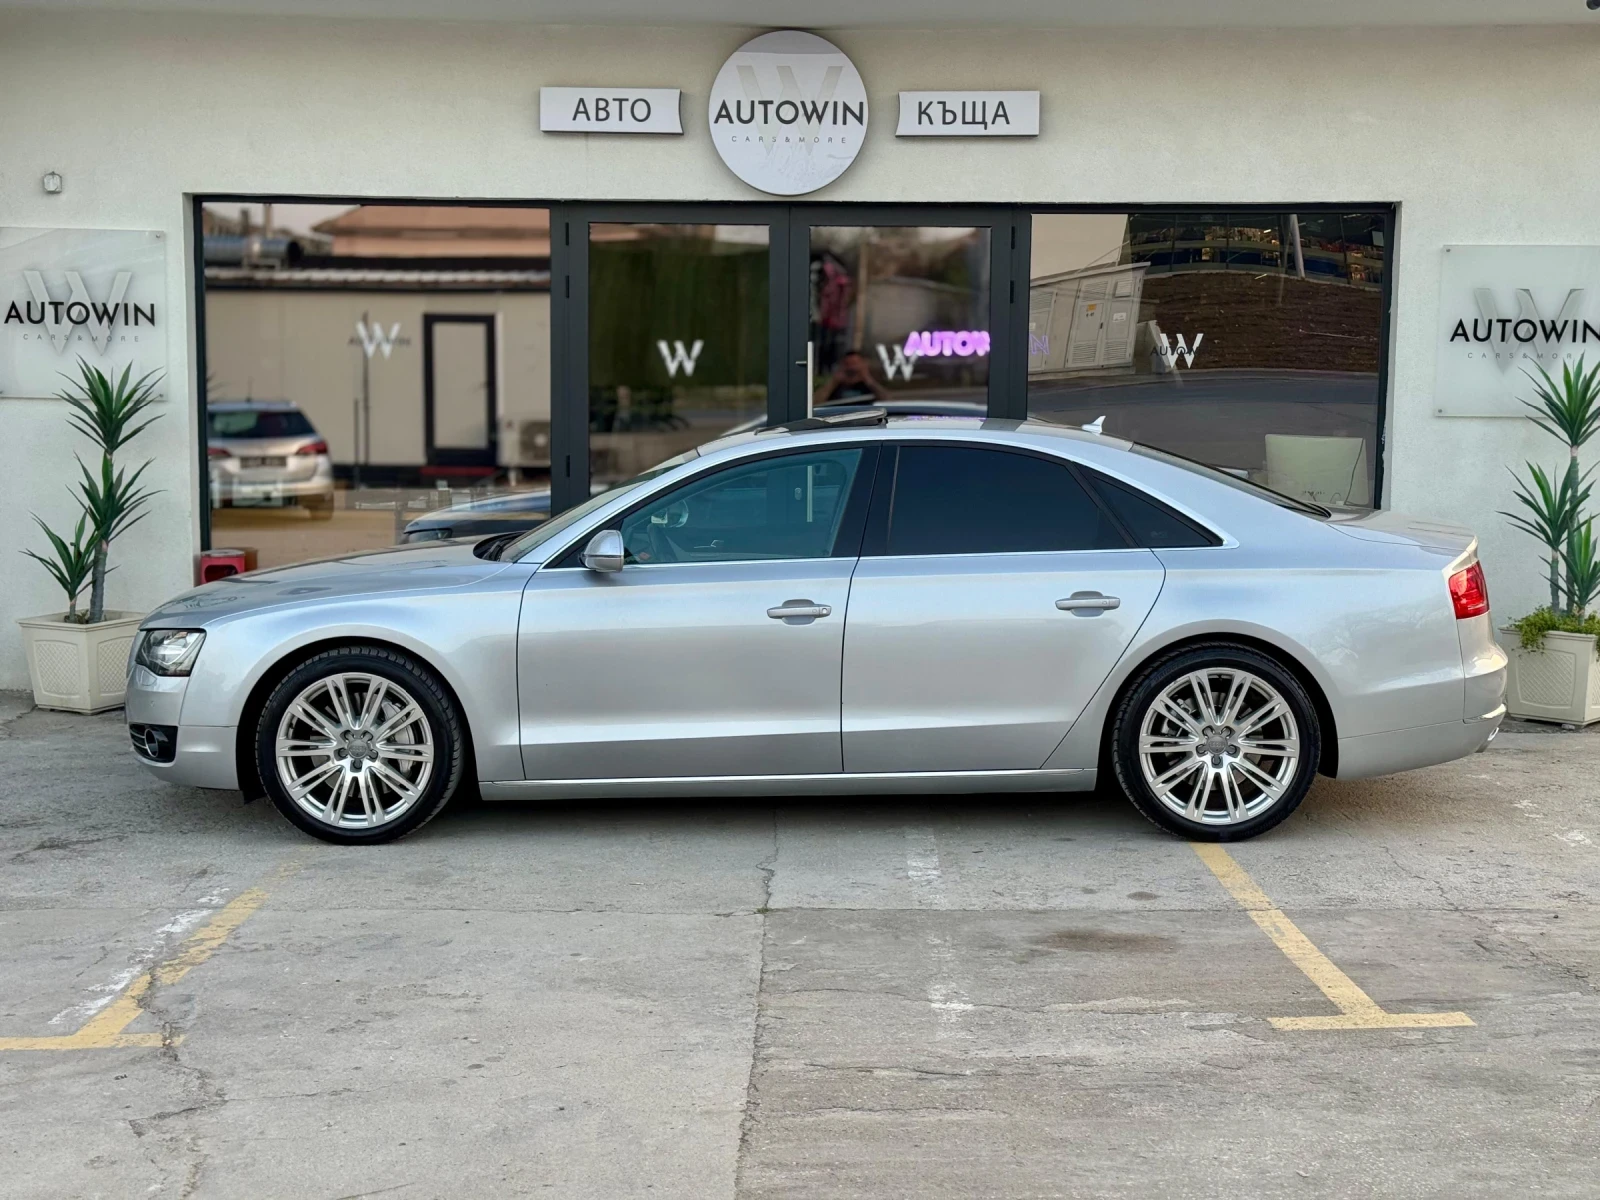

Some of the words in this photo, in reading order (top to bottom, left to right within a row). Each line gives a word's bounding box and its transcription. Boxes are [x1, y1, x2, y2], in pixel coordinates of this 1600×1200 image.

[572, 97, 651, 122] АВТО
[713, 99, 864, 126] AUTOWIN
[918, 100, 1010, 130] КЪЩА
[731, 135, 847, 144] CARS&MORE
[4, 300, 156, 326] AUTOWIN
[23, 333, 139, 342] CARS&MORE
[1449, 318, 1600, 344] AUTOWIN
[656, 339, 704, 378] W
[1467, 352, 1585, 360] CARS&MOR
